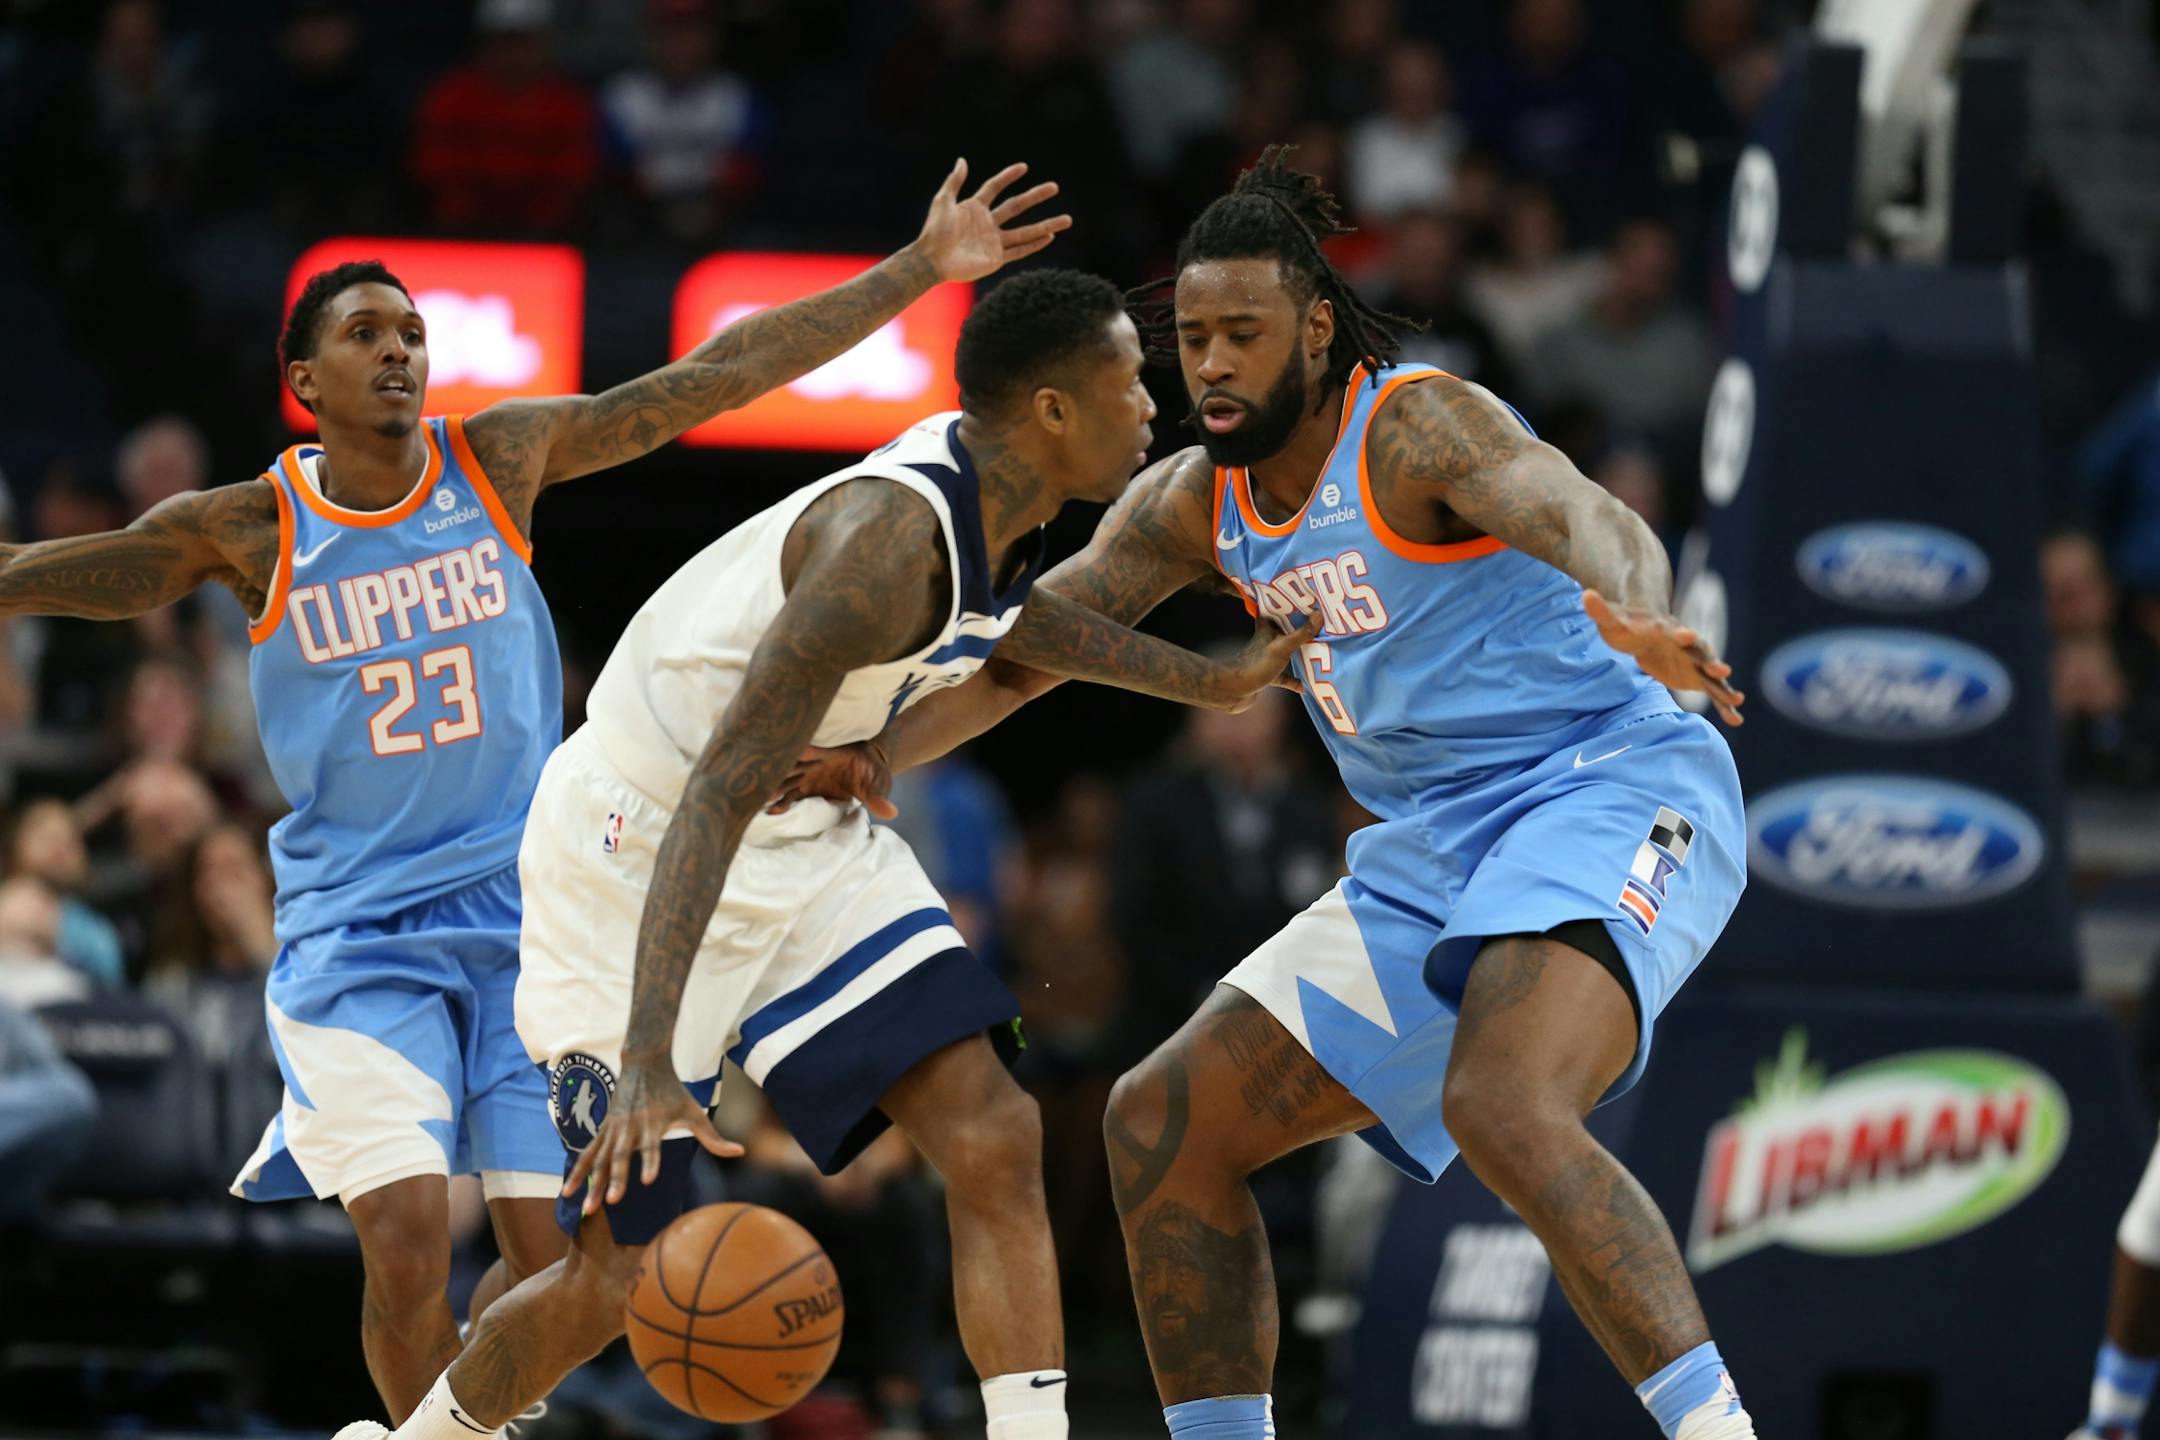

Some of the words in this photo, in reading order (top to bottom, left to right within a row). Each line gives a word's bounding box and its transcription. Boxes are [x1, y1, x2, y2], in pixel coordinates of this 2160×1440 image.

[424, 504, 480, 534] bumble
[1309, 506, 1357, 531] bumble
[44, 567, 153, 593] SUCCESS
[287, 537, 508, 664] CLIPPERS
[360, 644, 483, 756] 23
[1300, 641, 1358, 736] 6
[1708, 1088, 2031, 1240] LIBMAN
